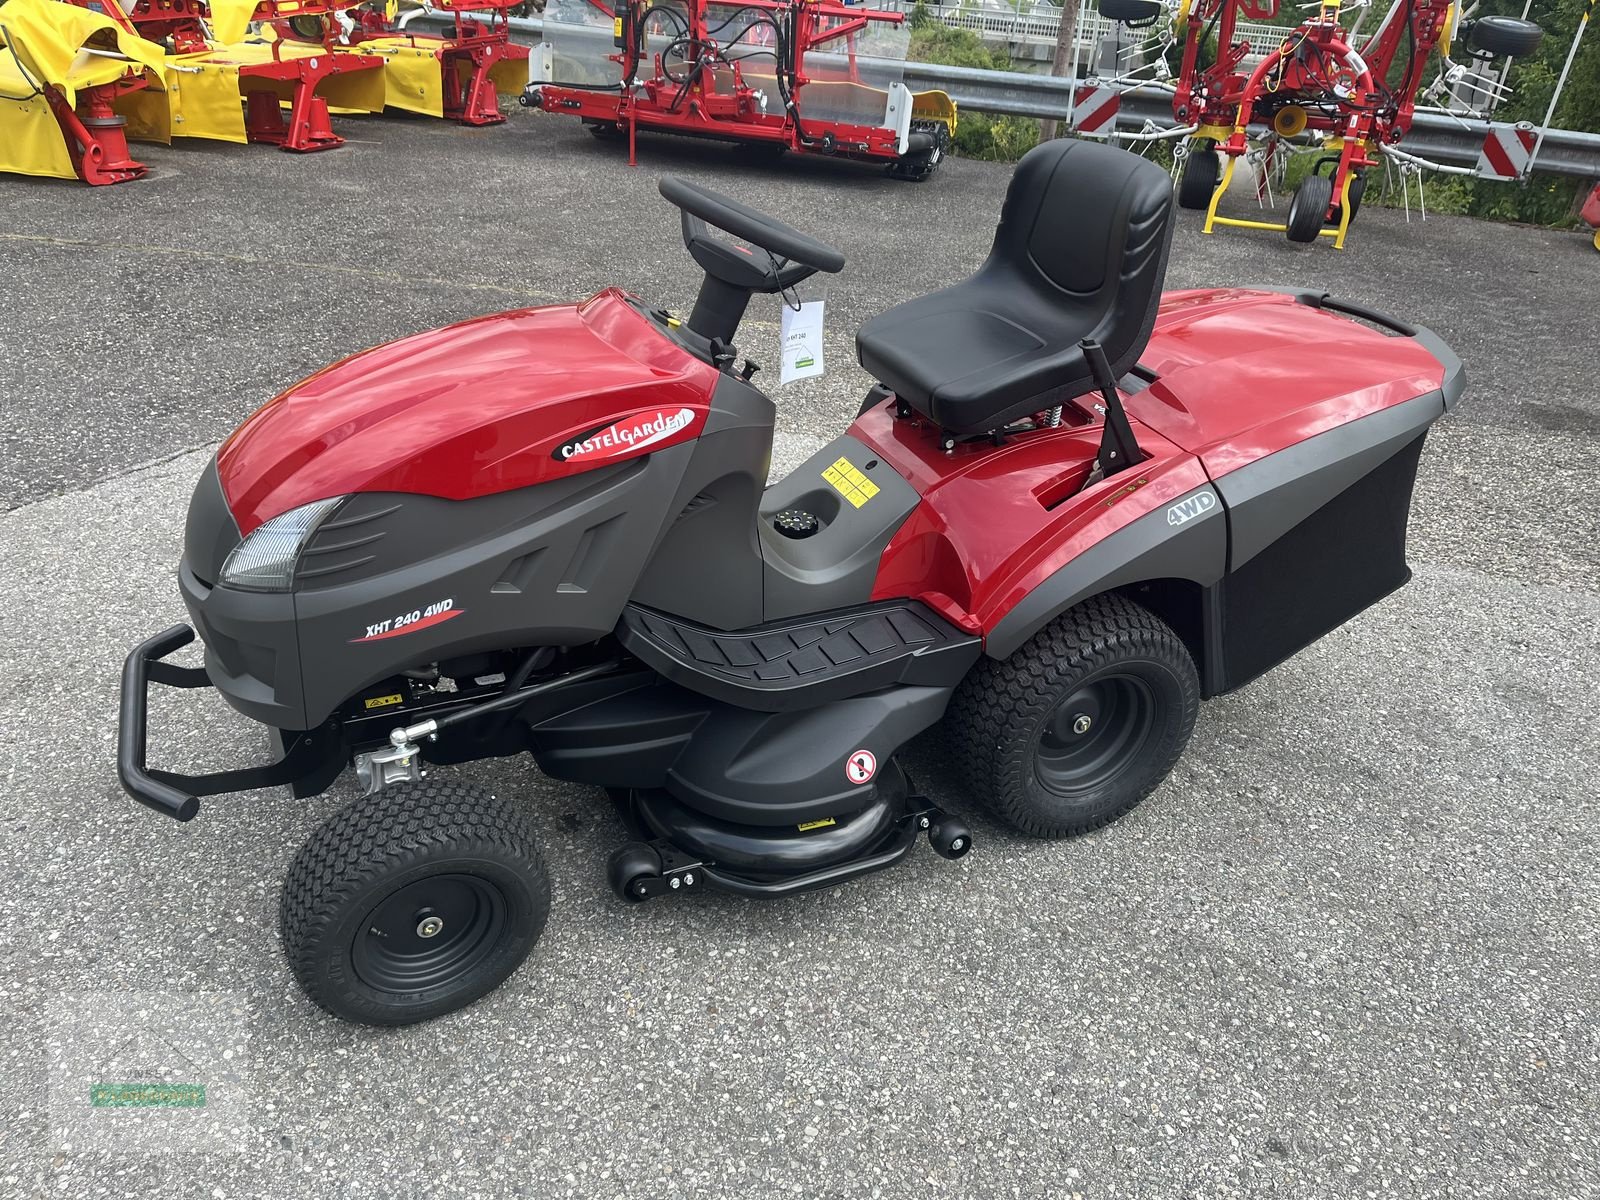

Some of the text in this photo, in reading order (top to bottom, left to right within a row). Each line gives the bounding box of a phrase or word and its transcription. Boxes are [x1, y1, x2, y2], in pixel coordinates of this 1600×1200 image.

[1168, 492, 1214, 525] 4WD
[365, 598, 453, 638] XHT 240 4WD
